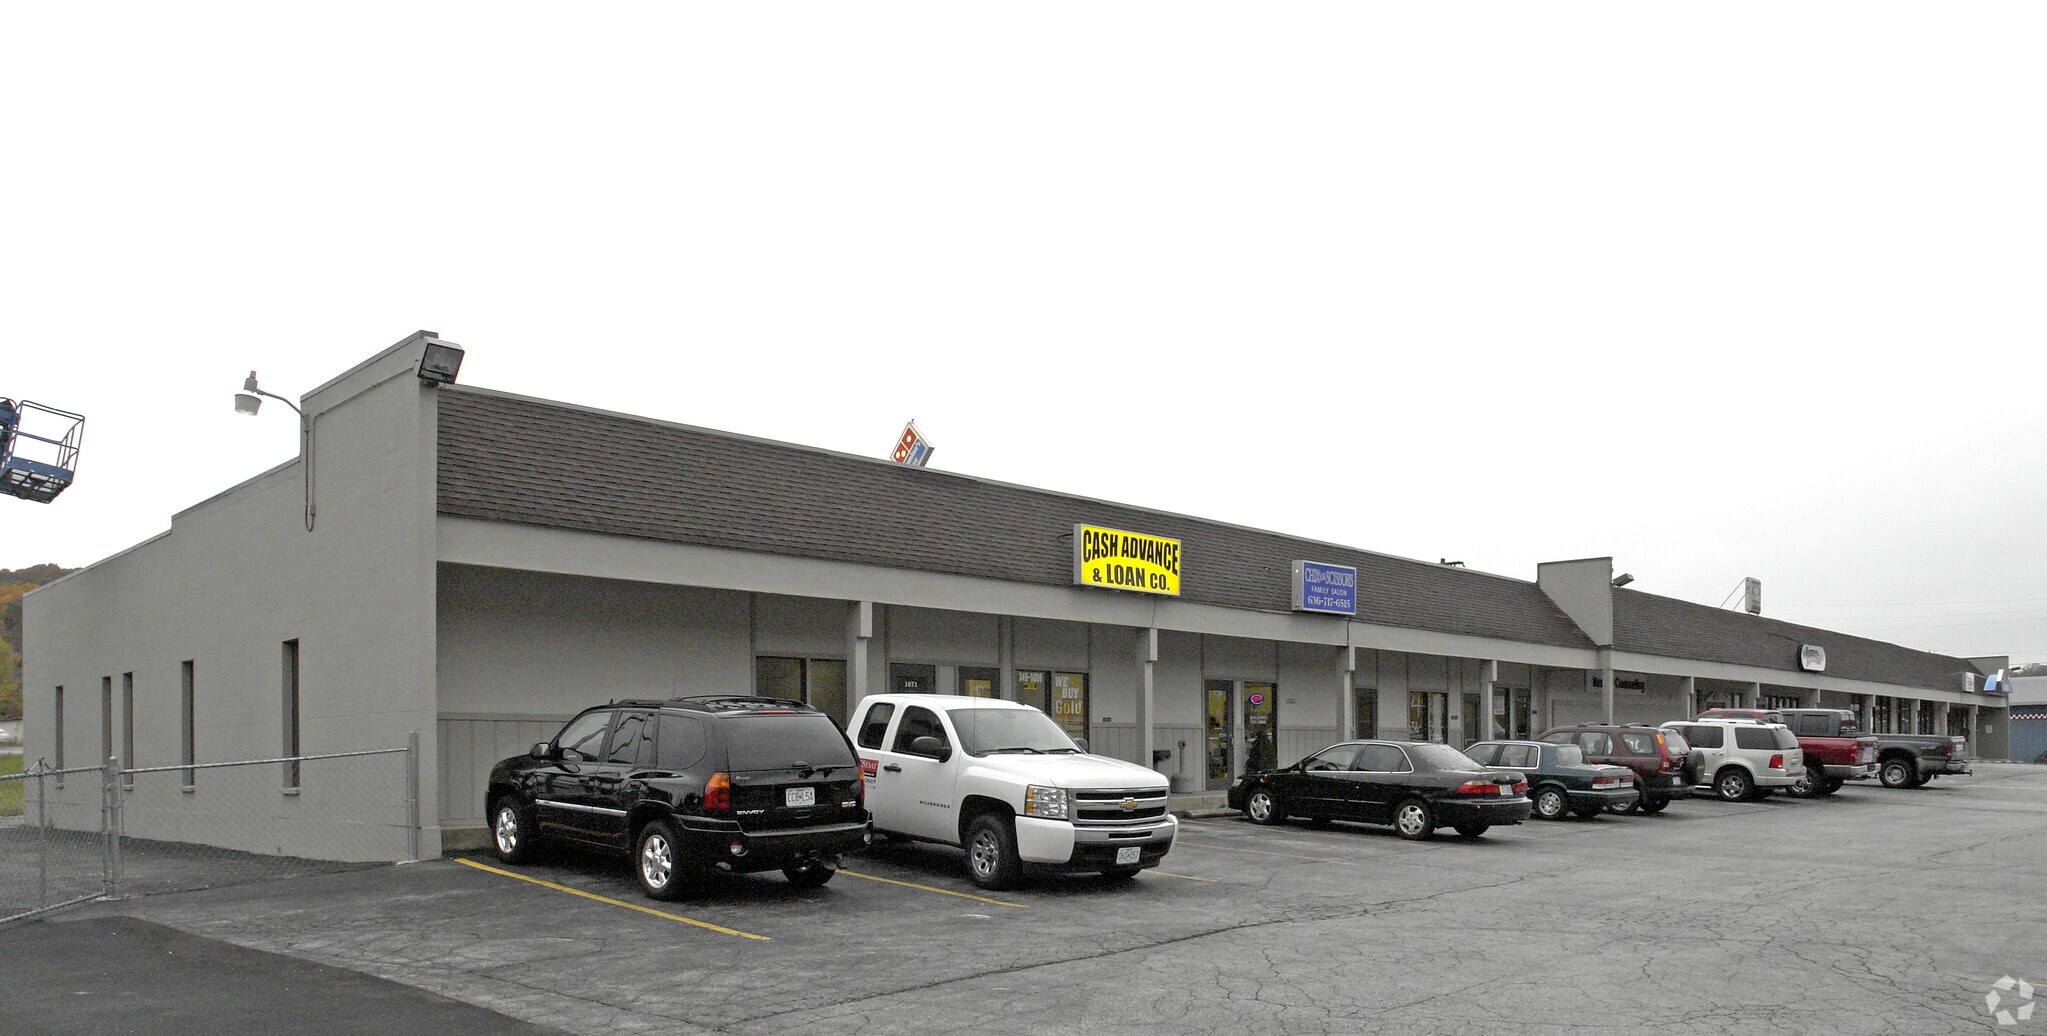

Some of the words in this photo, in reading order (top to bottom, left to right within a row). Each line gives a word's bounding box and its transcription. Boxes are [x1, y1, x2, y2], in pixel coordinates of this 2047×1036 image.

[1083, 530, 1118, 563] CASH
[1121, 536, 1178, 576] ADVANCE
[1093, 568, 1102, 582] &
[1106, 563, 1145, 588] LOAN
[1150, 573, 1170, 591] CO.
[1311, 586, 1328, 594] FAMILY
[1331, 588, 1347, 596] SALON
[1055, 676, 1069, 687] WE
[1061, 687, 1080, 699] BUY
[1055, 699, 1082, 715] Gold
